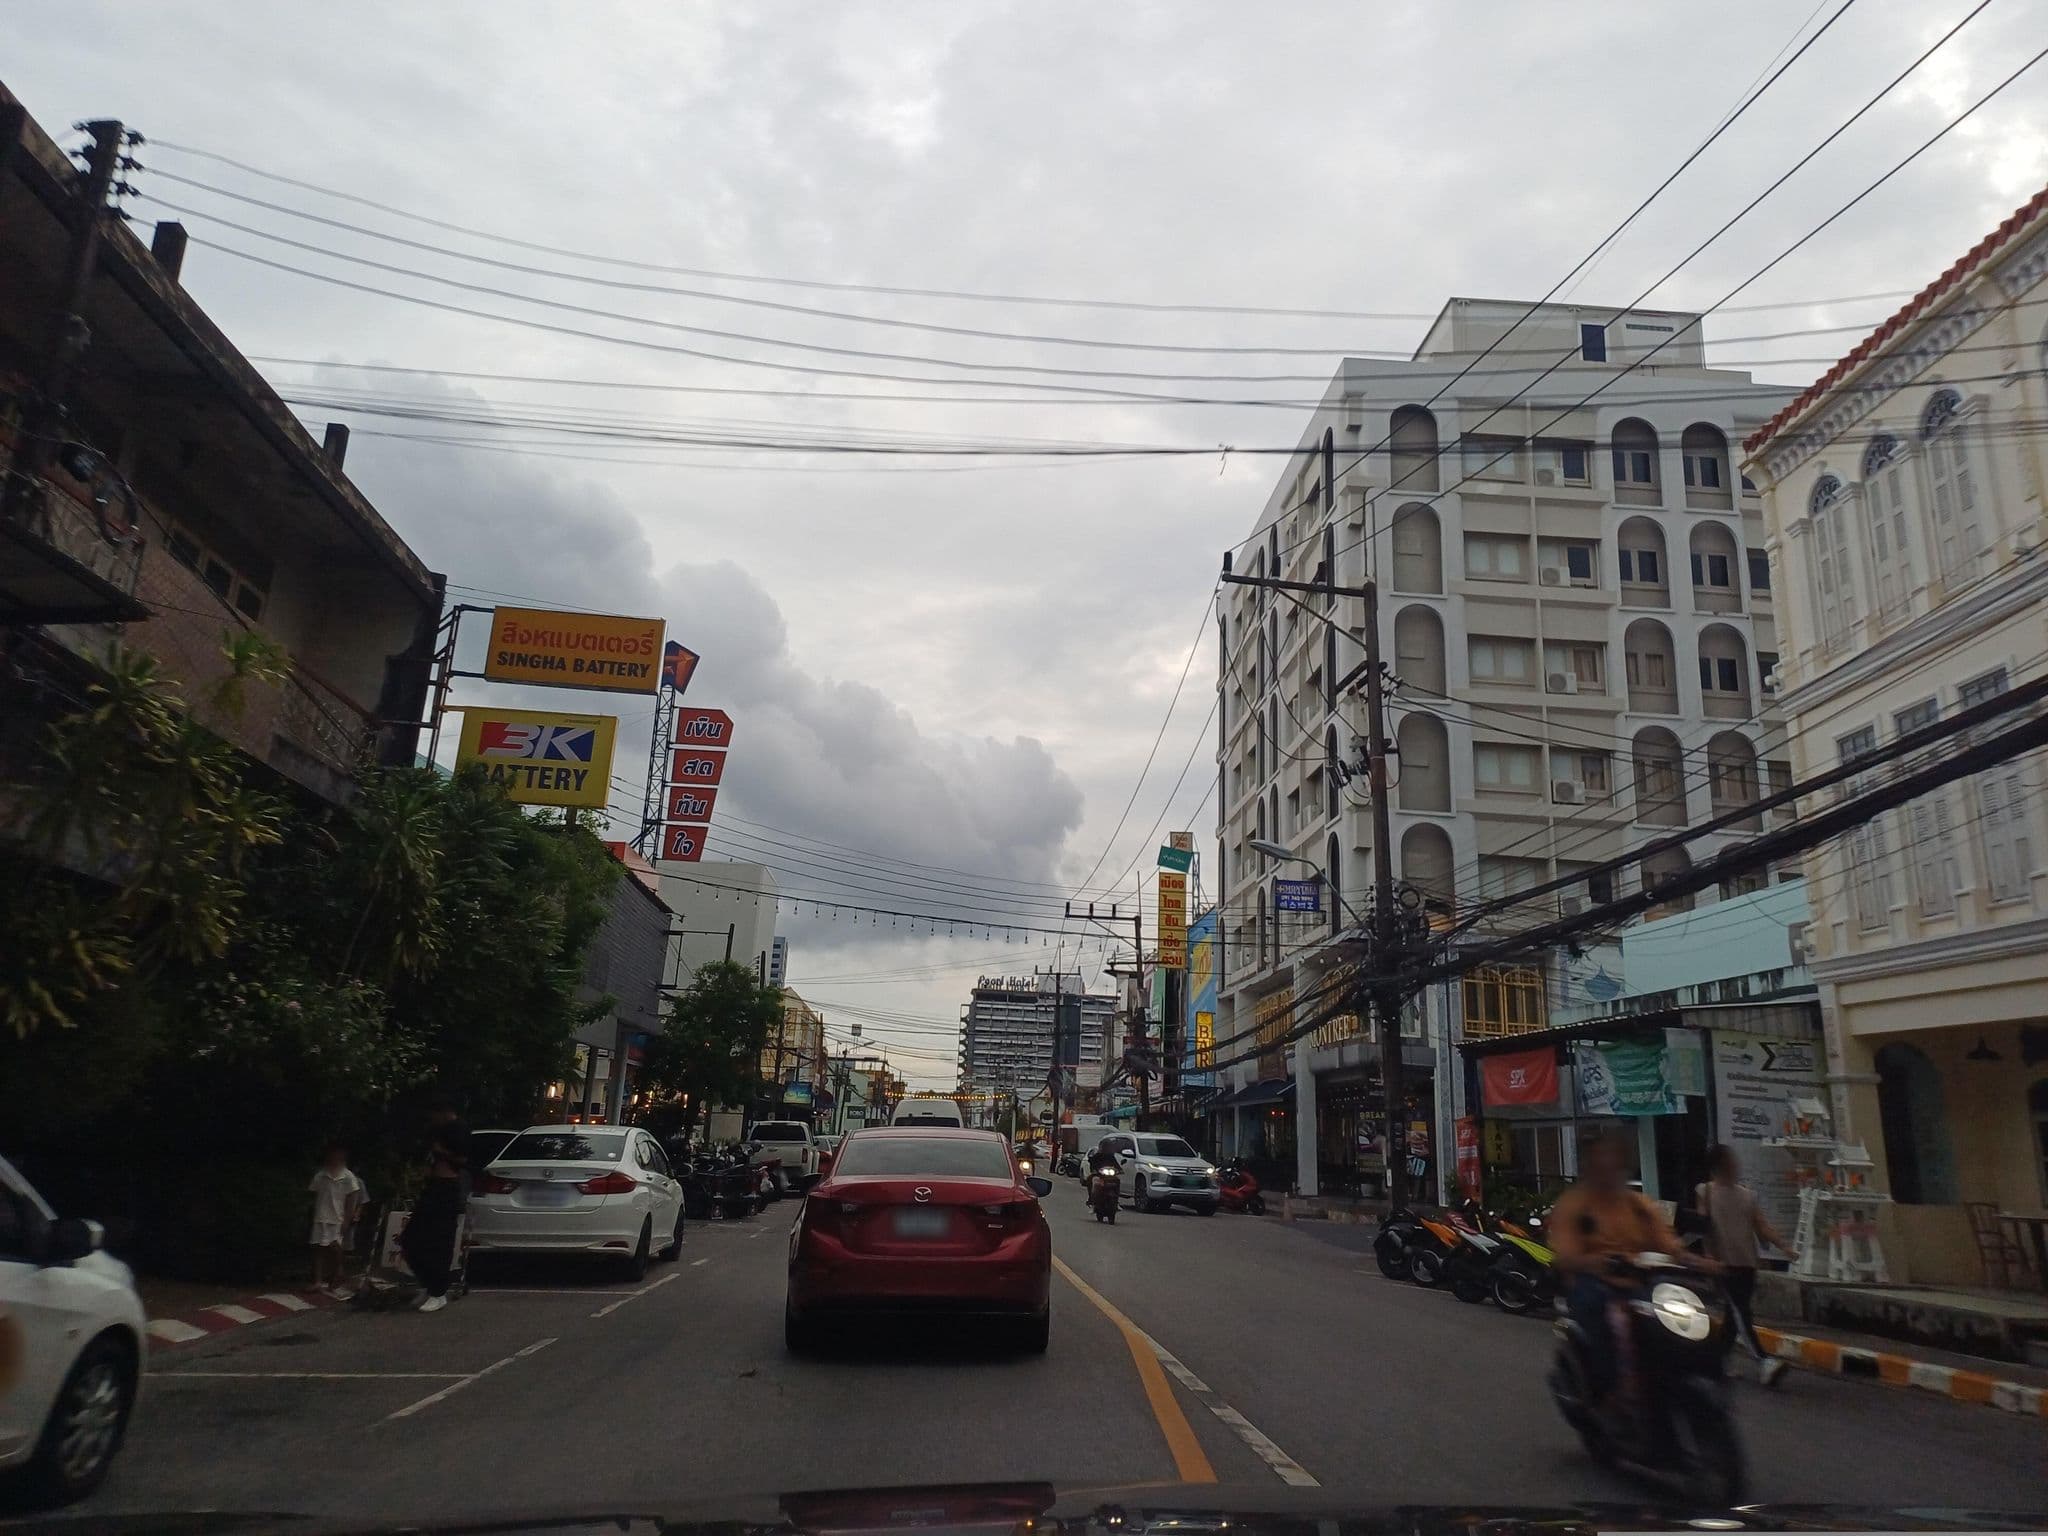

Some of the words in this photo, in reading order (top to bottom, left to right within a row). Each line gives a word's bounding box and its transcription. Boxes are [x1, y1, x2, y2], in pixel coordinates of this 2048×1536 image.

[497, 651, 567, 672] SINGHA
[573, 658, 652, 678] BATTERY
[684, 716, 724, 738] เงิน
[682, 758, 715, 777] สด
[674, 793, 708, 816] ทัน
[671, 830, 695, 855] ใจ
[1198, 1025, 1211, 1068] BAR
